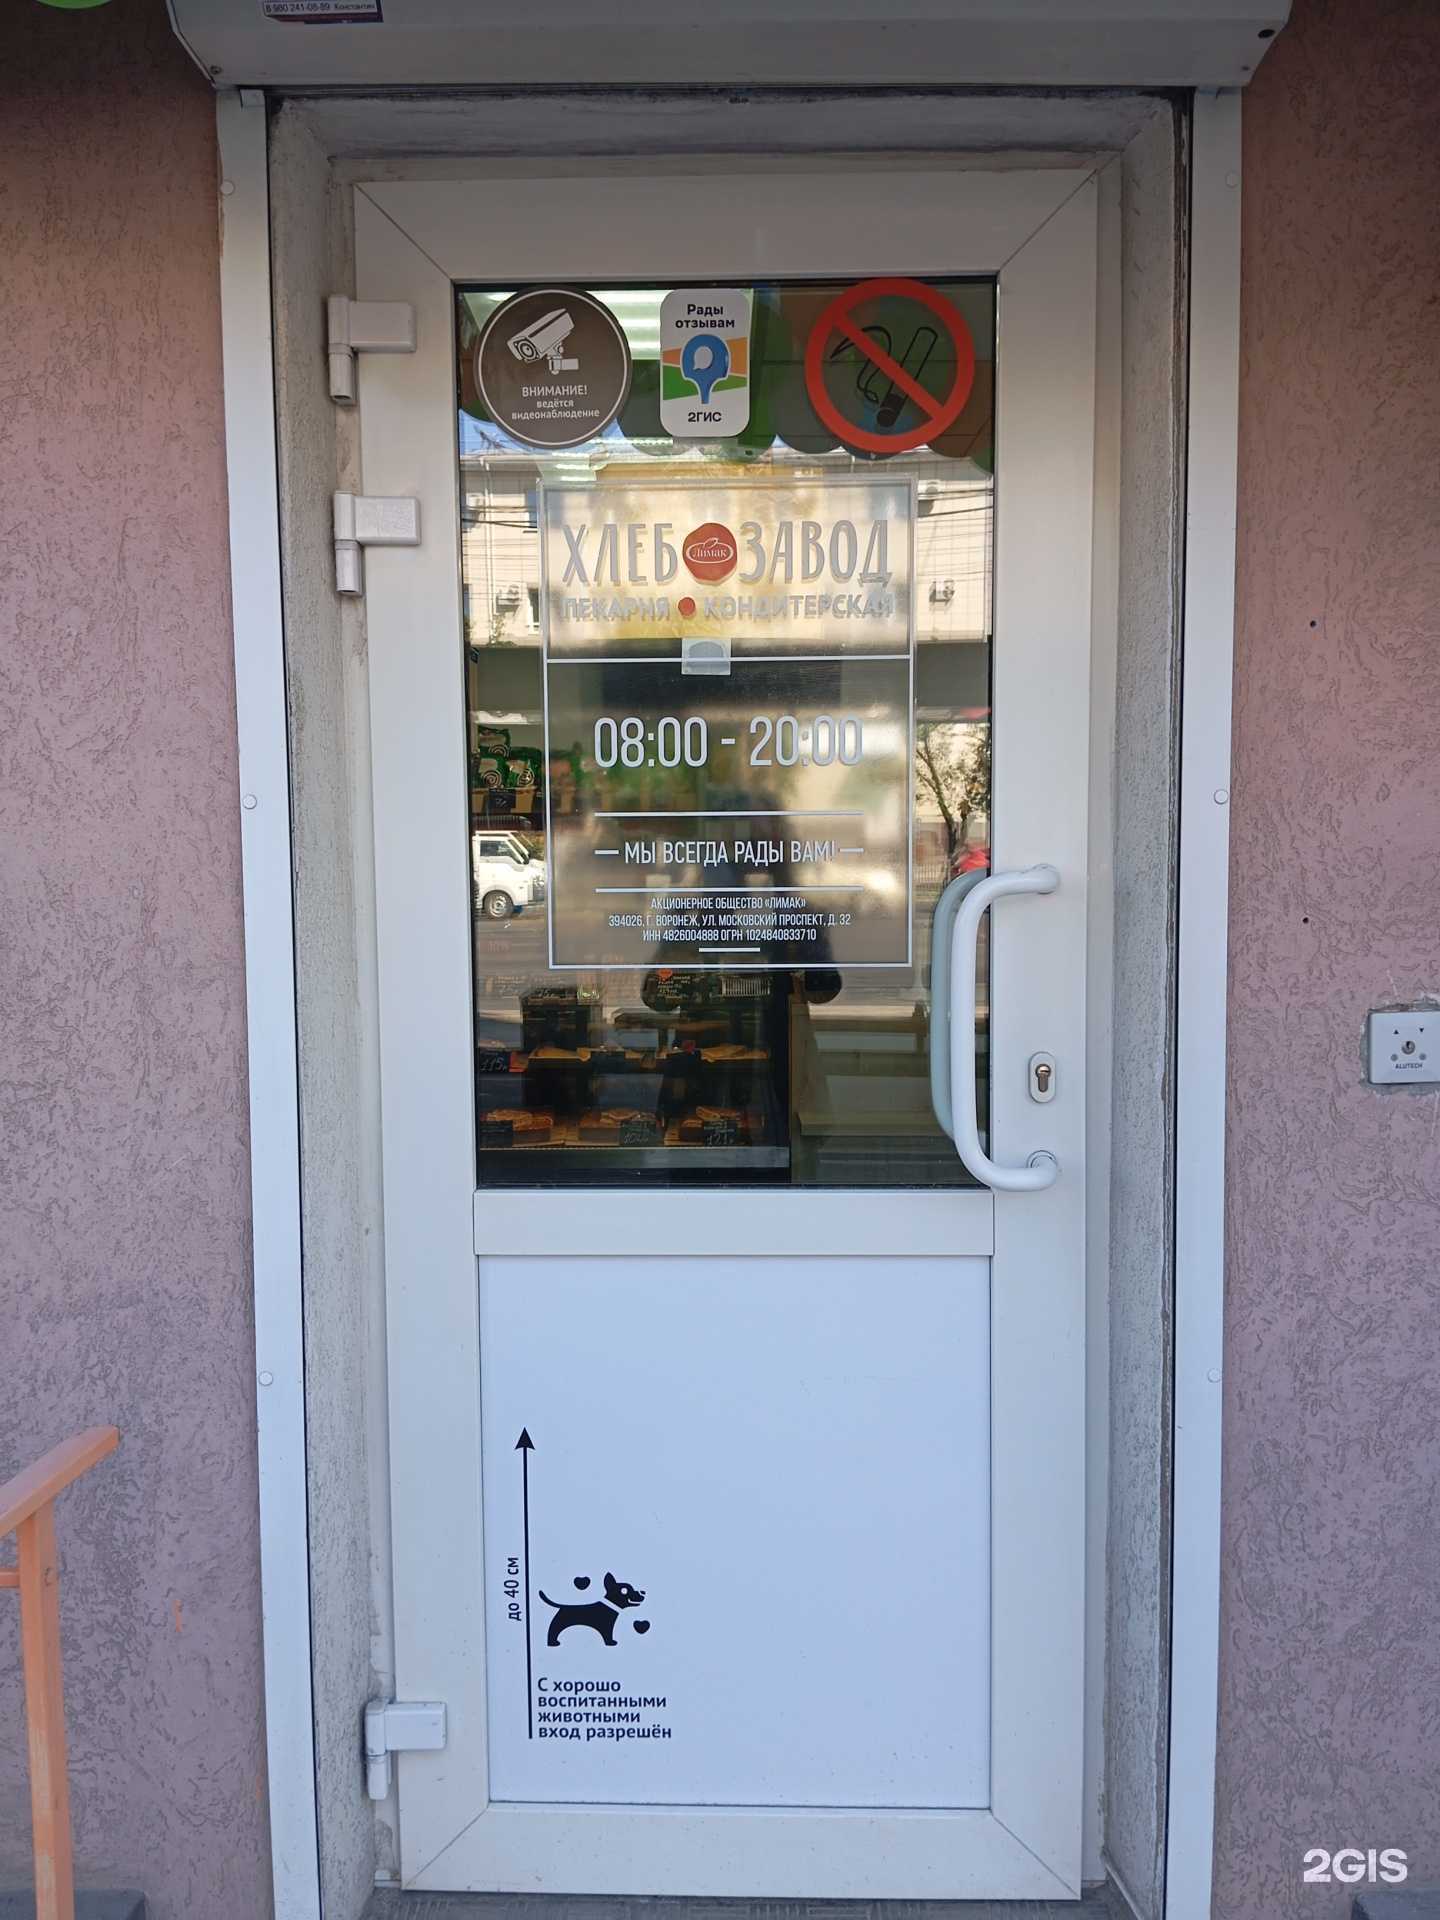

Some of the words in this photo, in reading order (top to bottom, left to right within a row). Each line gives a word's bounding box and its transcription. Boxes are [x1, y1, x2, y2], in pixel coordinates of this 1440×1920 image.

[687, 303, 724, 317] Рады
[675, 319, 735, 329] отзывам
[521, 384, 588, 397] ВНИМАНИЕ!
[536, 399, 574, 409] ведётся
[511, 409, 600, 421] видеонаблюдение
[687, 411, 722, 423] 2ГИС
[561, 522, 679, 585] ХЛЕБ
[738, 519, 893, 587] ЗАВОД
[560, 597, 670, 622] ПЕКАРНЯ
[703, 594, 896, 621] КОНДИТЕРСКАЯ
[594, 716, 708, 768] 08:00
[749, 714, 864, 767] 20:00
[624, 841, 656, 865] МЫ
[663, 840, 728, 868] ВСЕГДА
[734, 840, 784, 867] РАДЫ
[791, 840, 836, 864] ВАМ!
[651, 897, 714, 910] АКЦИОНЕРНОЕ
[715, 897, 763, 910] ОБЩЕСТВО
[764, 896, 806, 909] «ЛИМАК»
[608, 914, 645, 928] 394026,
[655, 914, 701, 928] ВОРОНЕЖ,
[702, 914, 716, 927] УЛ.
[718, 912, 777, 927] МОСКОВСКИЙ
[779, 913, 827, 927] ПРОСПЕКТ,
[839, 913, 851, 926] 32
[643, 929, 661, 941] ИНН
[662, 929, 719, 941] 4826004888
[720, 929, 743, 941] ОГРН
[746, 928, 817, 941] 1024840833710
[507, 1557, 519, 1575] см
[503, 1580, 519, 1598] 40
[508, 1602, 522, 1622] до
[537, 1677, 548, 1692] С
[553, 1680, 622, 1696] хорошо
[538, 1696, 667, 1708] воспитанными
[537, 1712, 641, 1723] животными
[538, 1727, 581, 1740] вход
[586, 1724, 672, 1741] разрешён
